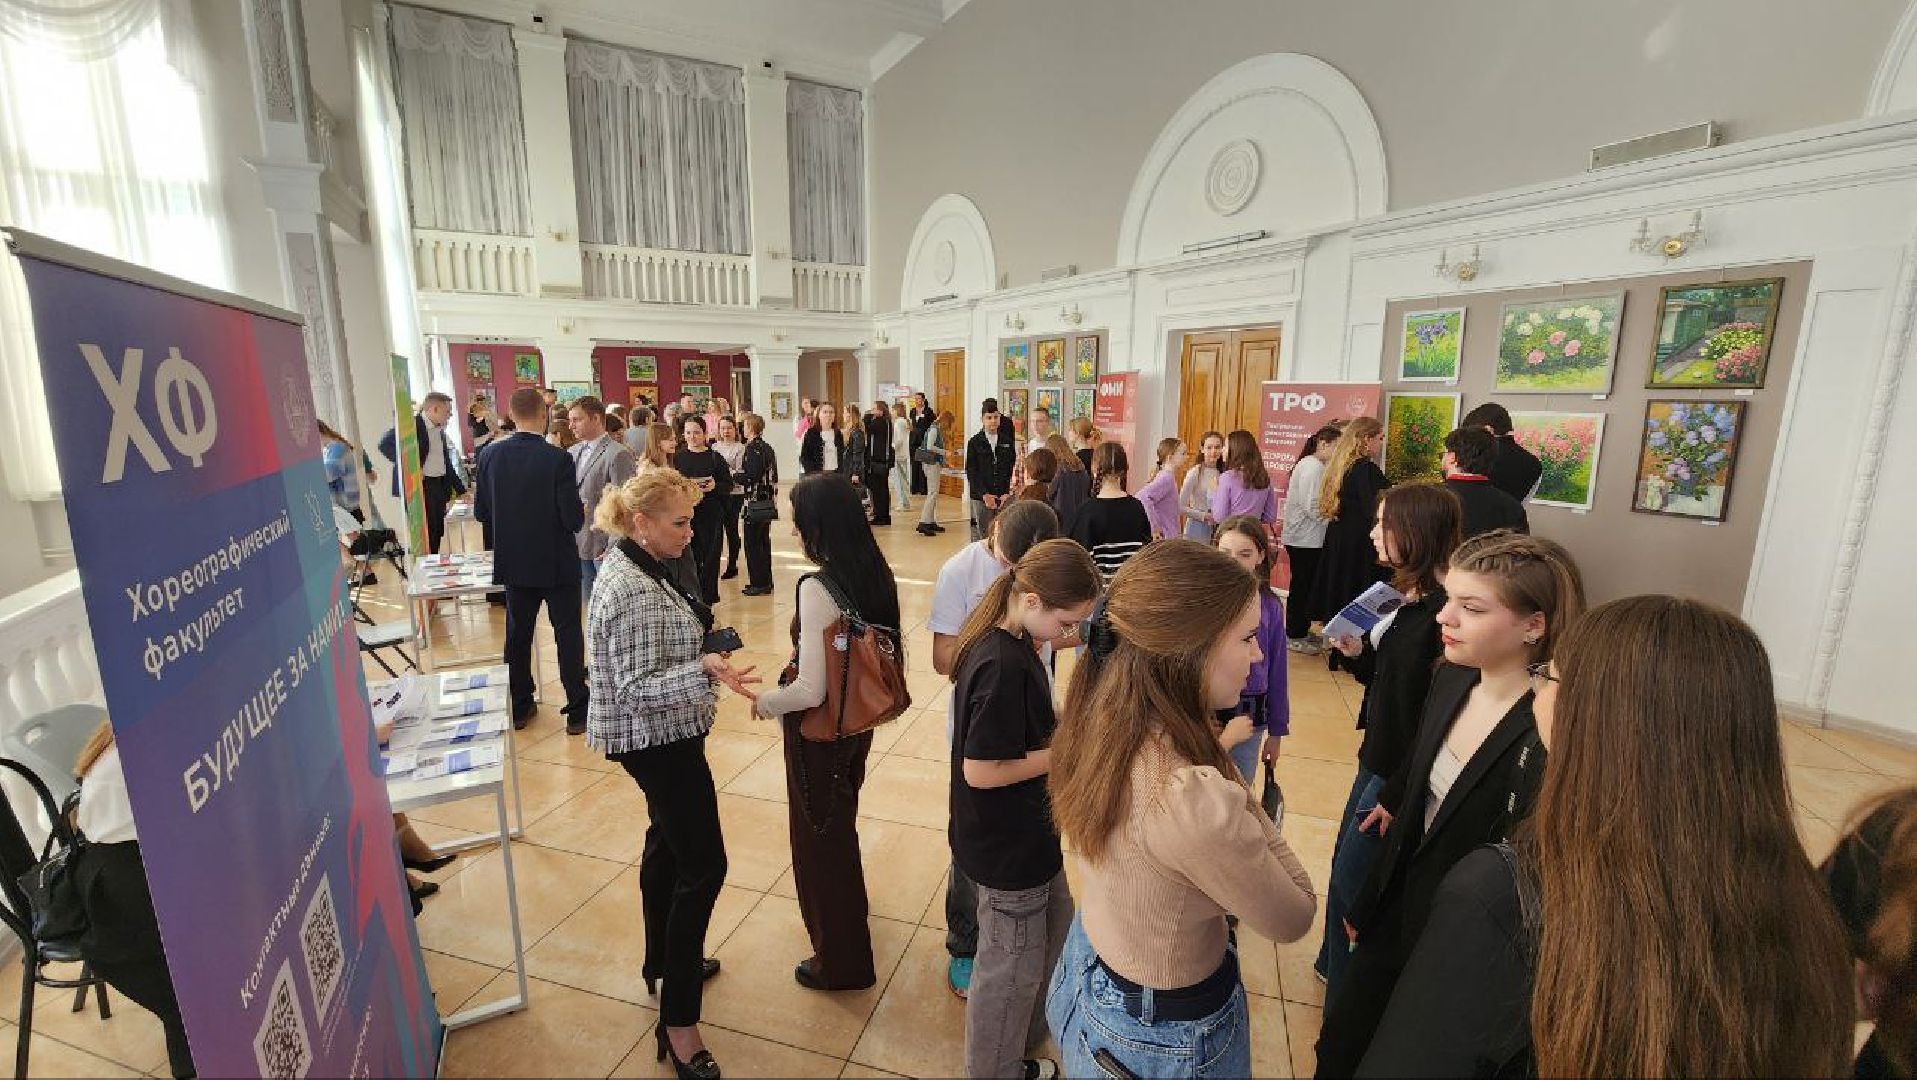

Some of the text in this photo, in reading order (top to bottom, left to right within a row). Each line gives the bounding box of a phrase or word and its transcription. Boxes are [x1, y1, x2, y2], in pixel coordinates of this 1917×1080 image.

[78, 343, 218, 485] ХФ
[1269, 391, 1326, 414] ТРФ
[126, 508, 291, 623] Хореографический
[144, 587, 245, 681] факультет
[183, 668, 287, 814] БУДУЩЕЕ
[286, 646, 309, 688] ЗА
[240, 878, 300, 1009] Контактные
